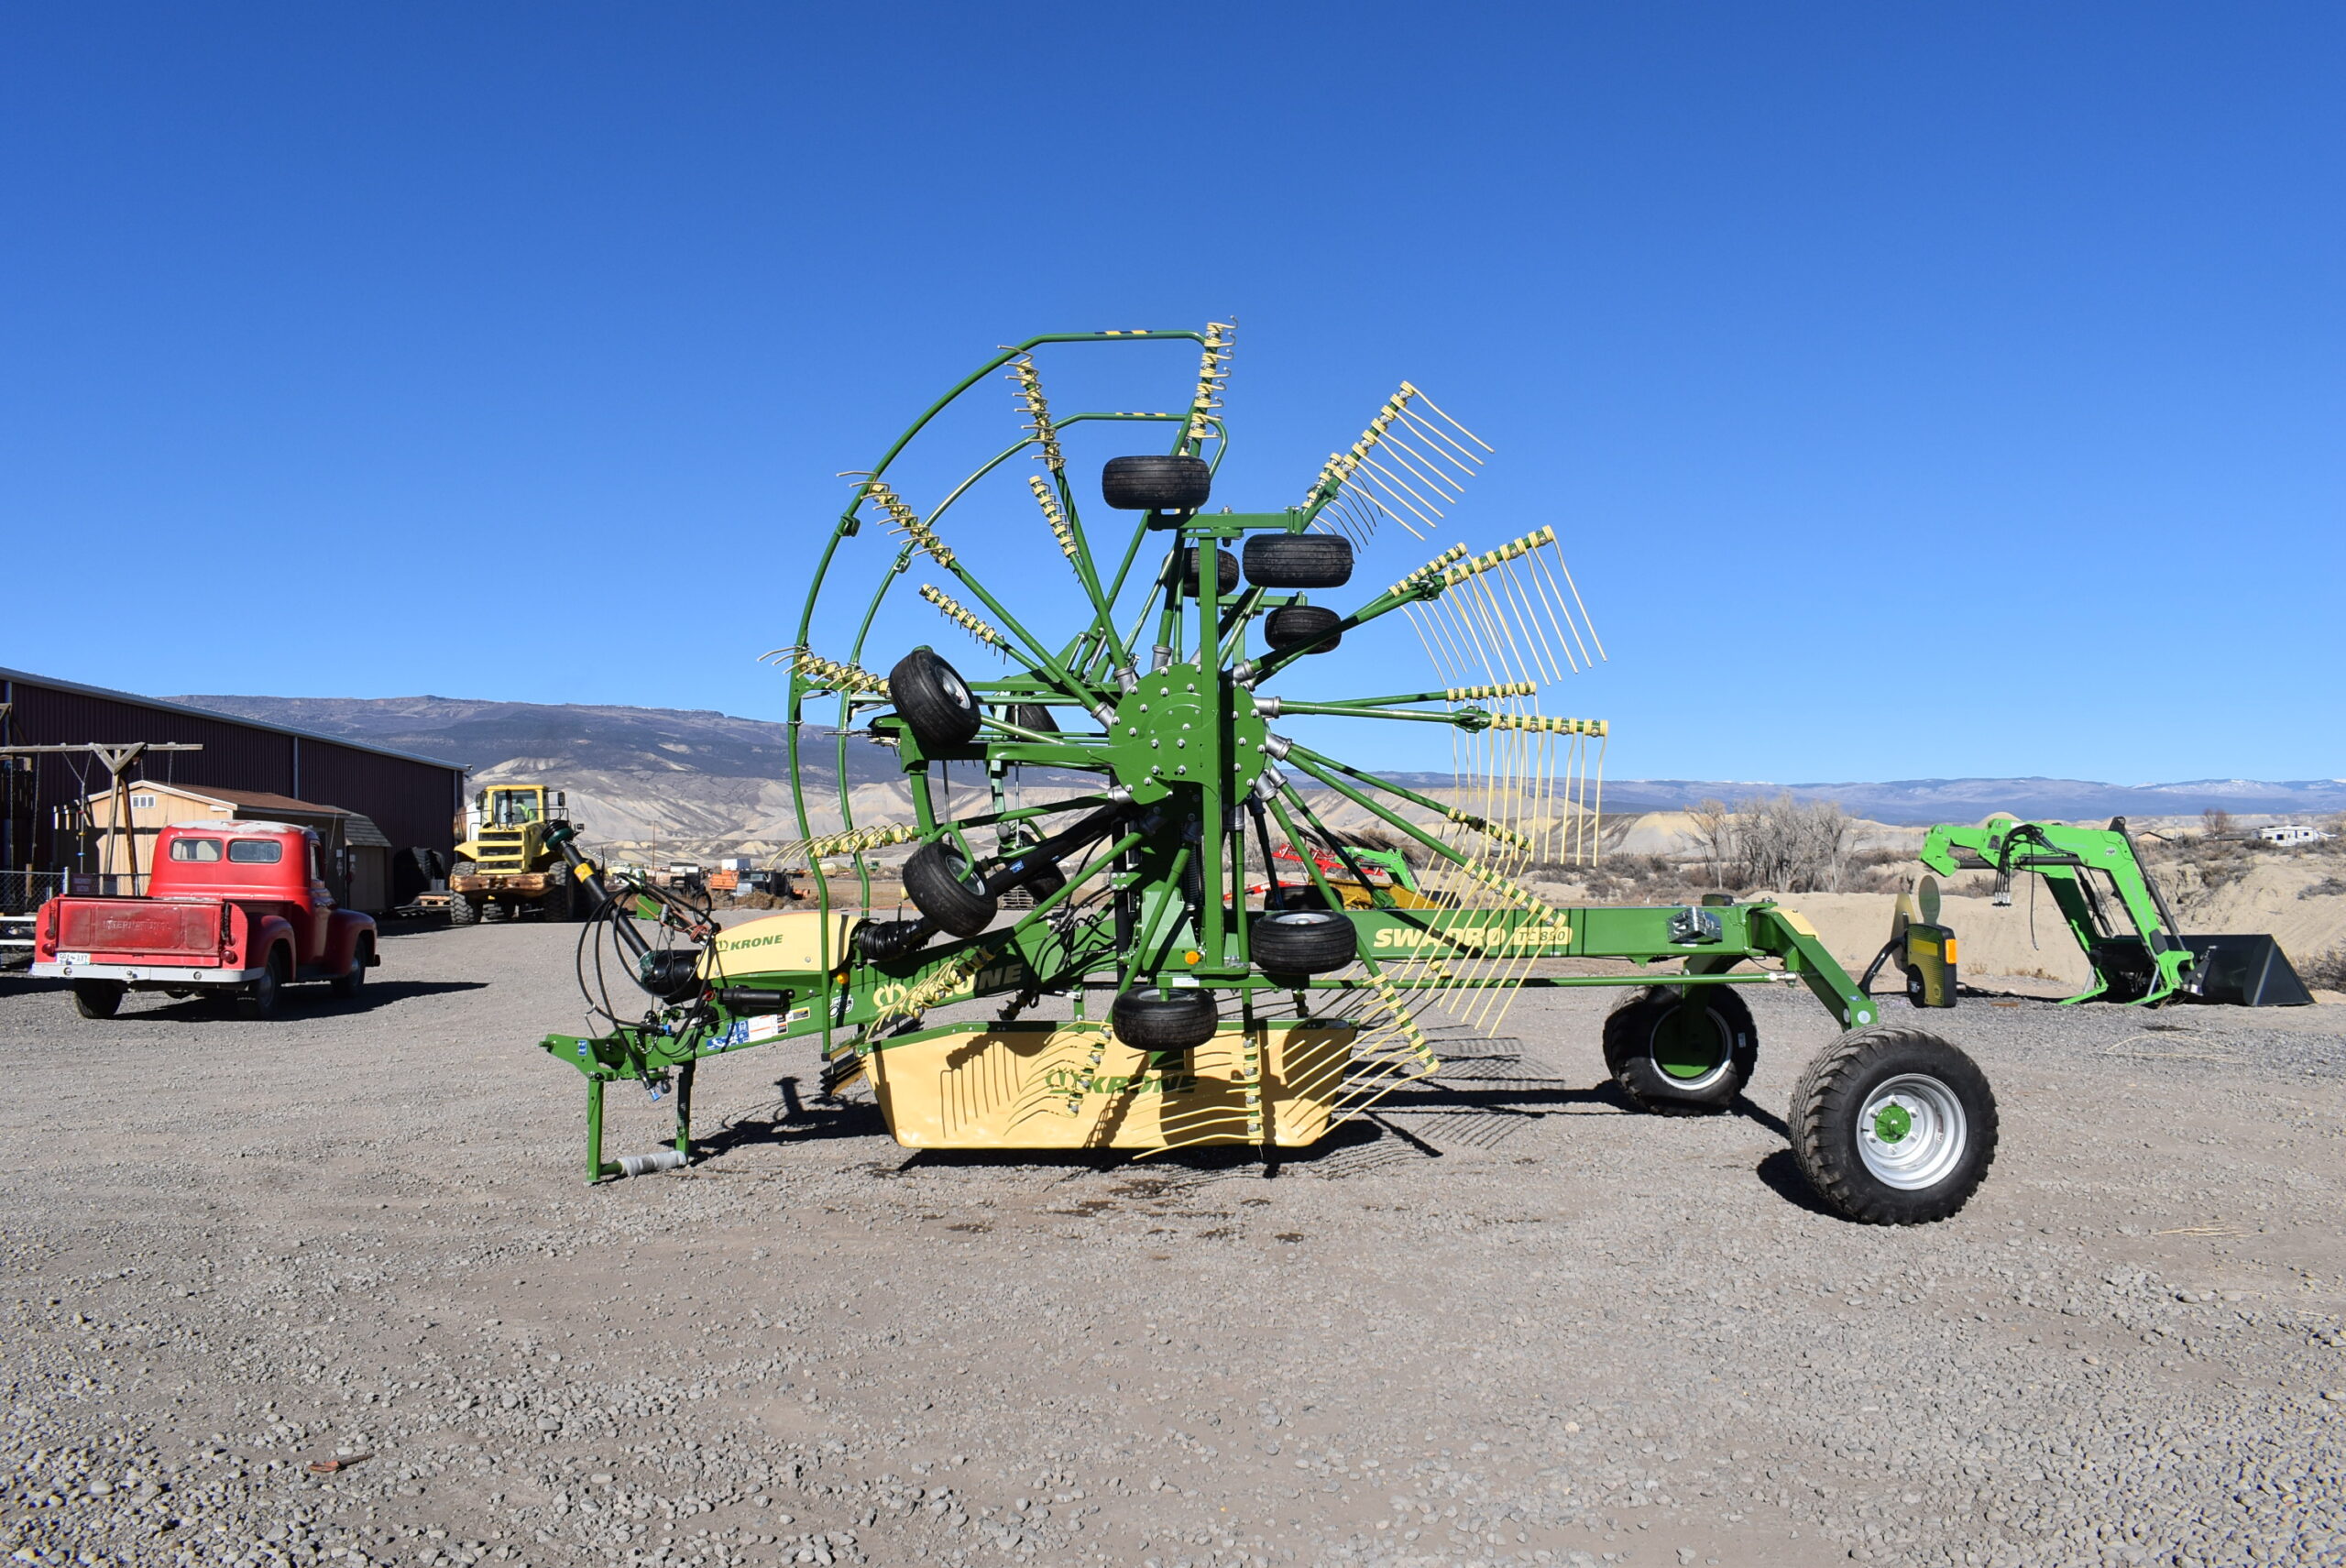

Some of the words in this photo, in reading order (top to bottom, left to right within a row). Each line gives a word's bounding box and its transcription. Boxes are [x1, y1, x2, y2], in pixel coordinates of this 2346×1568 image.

[730, 935, 784, 950] KRONE
[1374, 927, 1507, 948] SWADRO
[1089, 1076, 1199, 1093] KRONE
